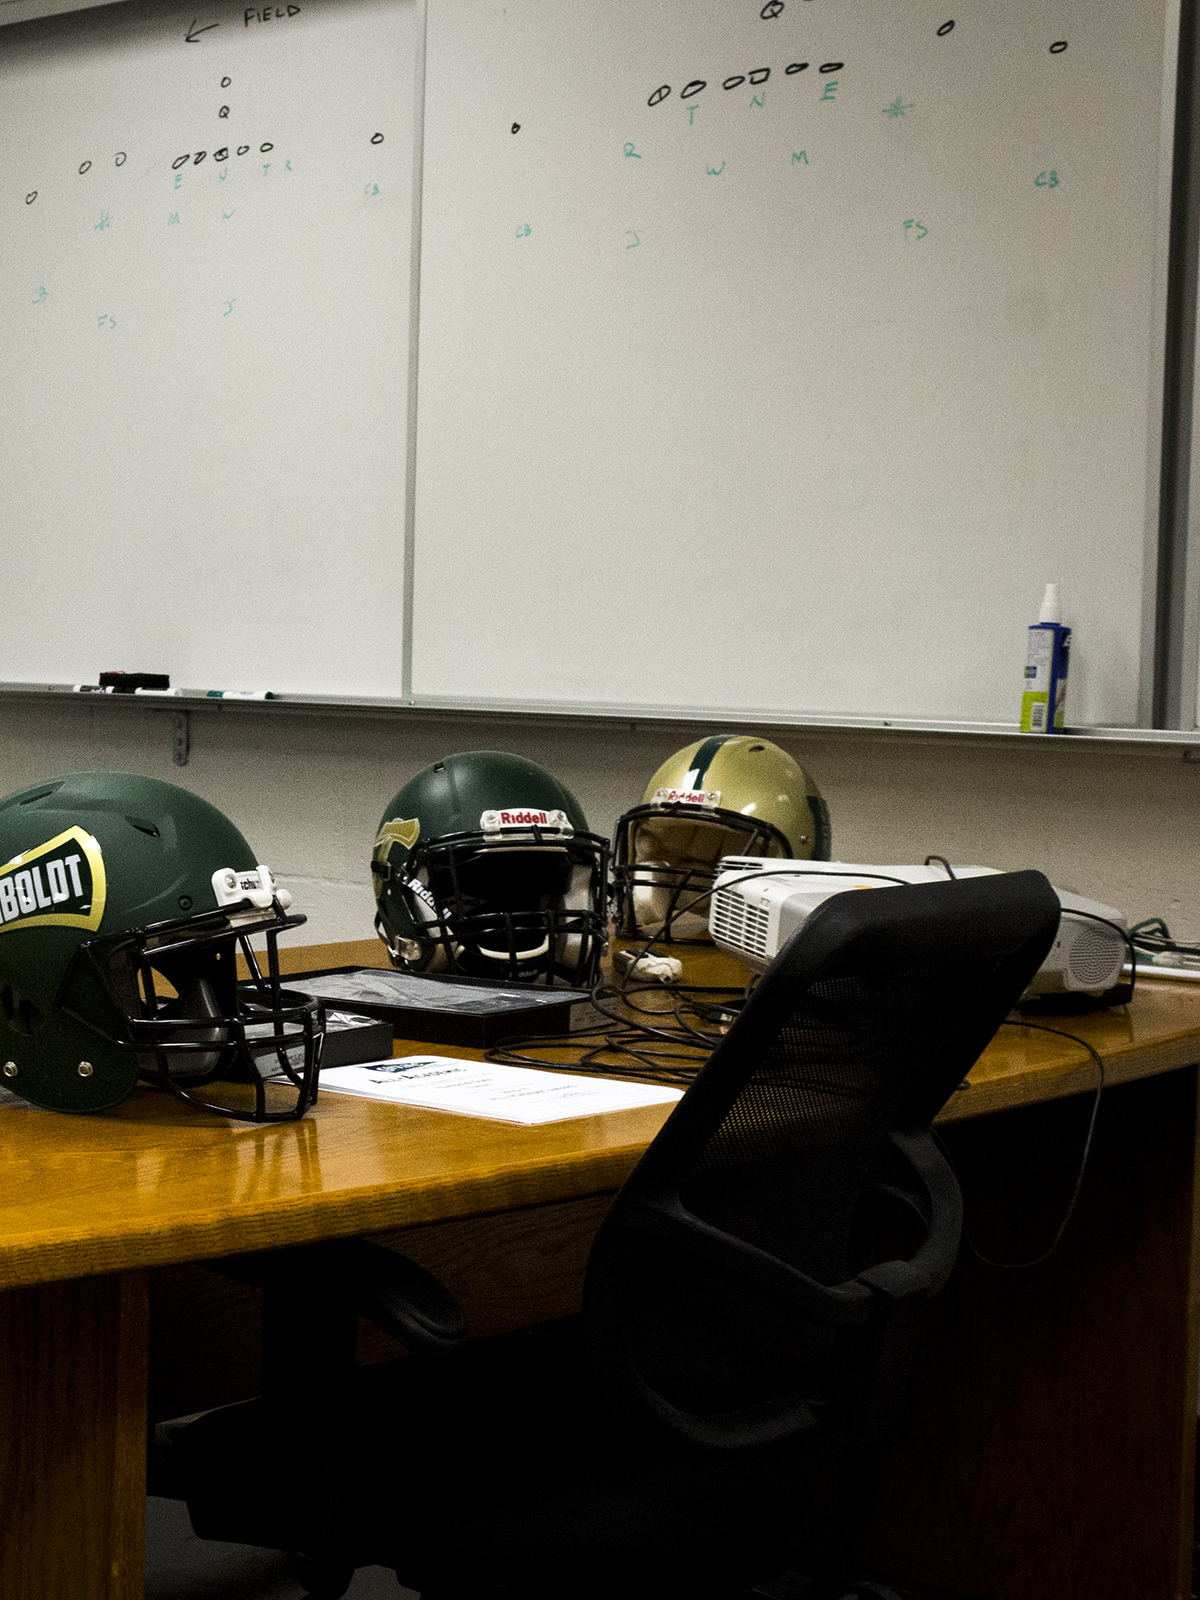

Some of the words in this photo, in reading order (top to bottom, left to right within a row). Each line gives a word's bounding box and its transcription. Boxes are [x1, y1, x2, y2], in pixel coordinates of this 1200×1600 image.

[243, 4, 301, 28] FIELD
[820, 81, 838, 101] E
[686, 105, 699, 126] T
[500, 811, 548, 825] Riddell
[407, 878, 452, 919] Riddll
